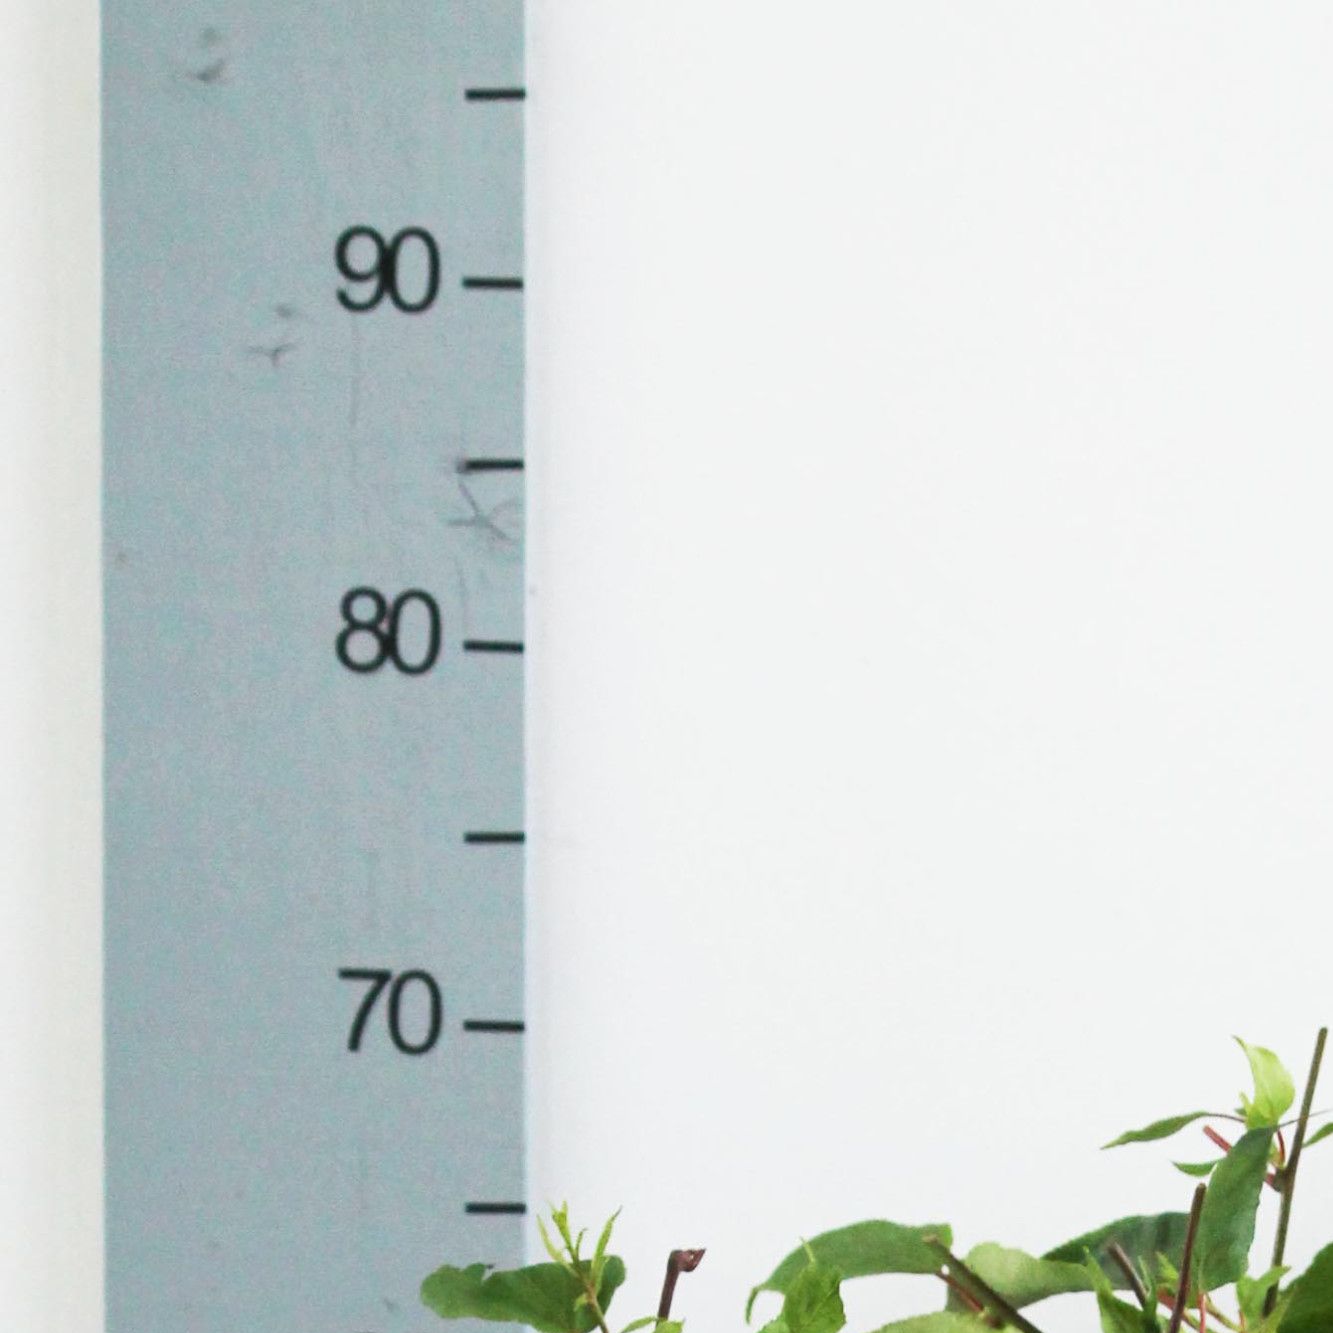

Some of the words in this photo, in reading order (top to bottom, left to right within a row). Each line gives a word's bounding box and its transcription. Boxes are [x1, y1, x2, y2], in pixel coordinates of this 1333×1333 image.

[335, 226, 441, 314] 90
[335, 587, 442, 676] 80
[338, 968, 444, 1056] 70
